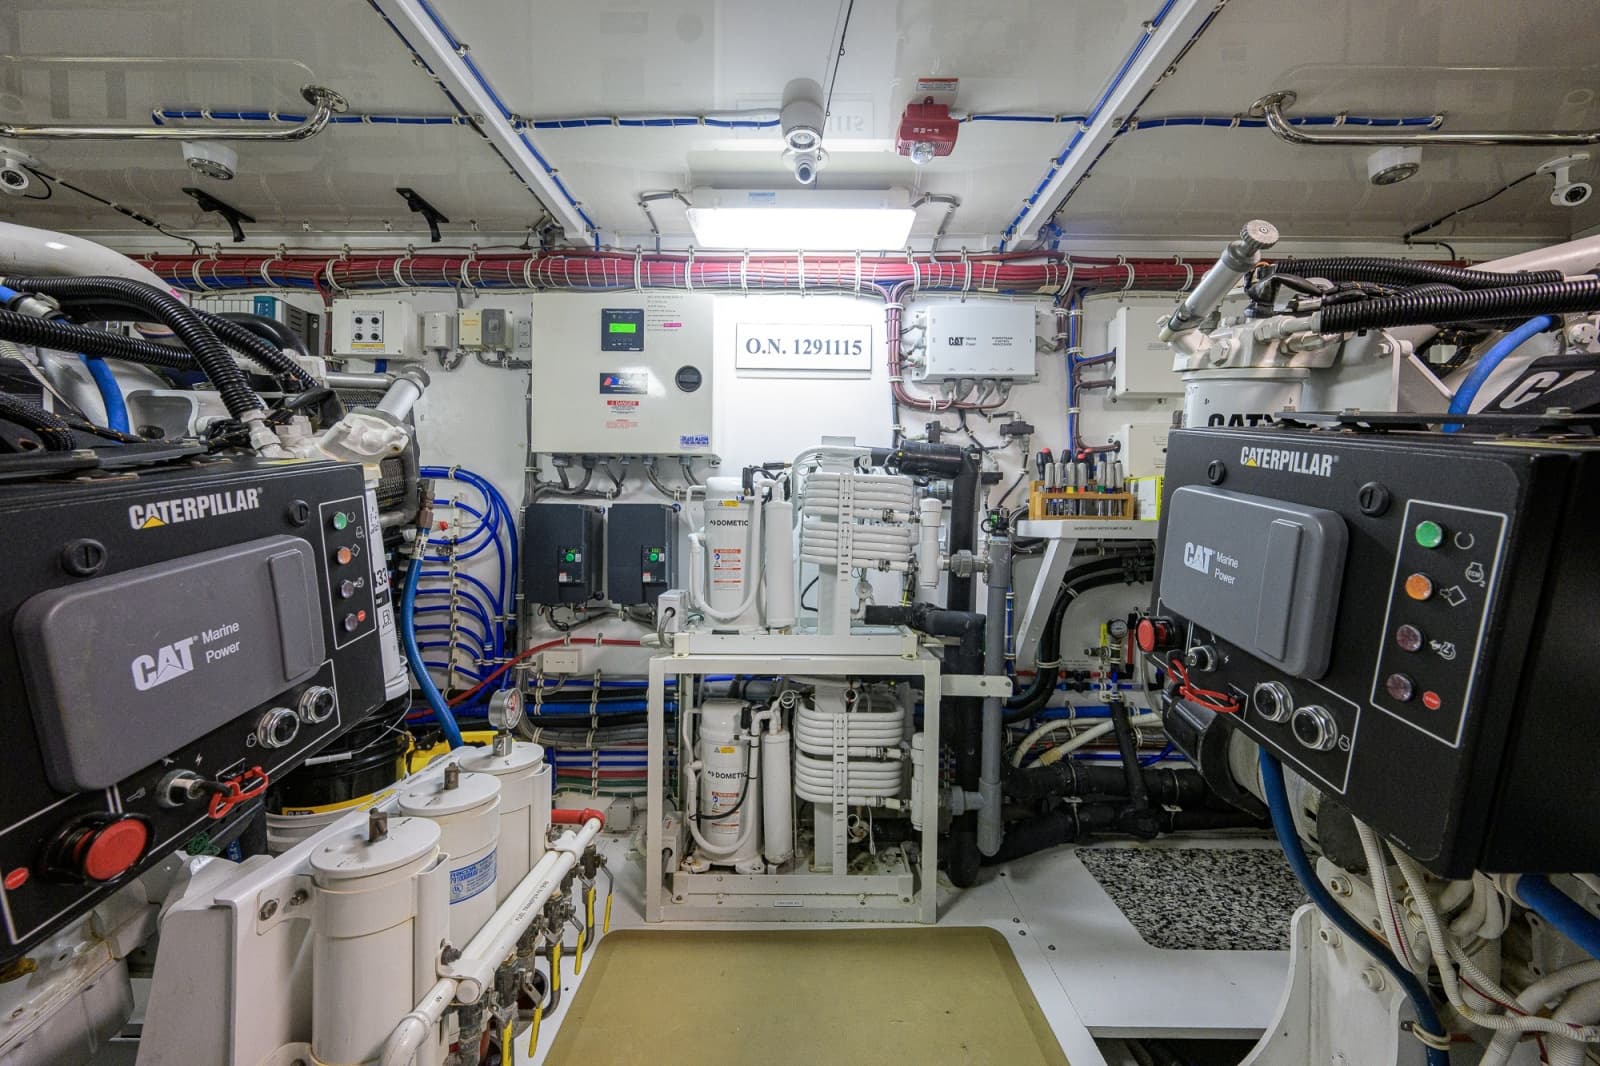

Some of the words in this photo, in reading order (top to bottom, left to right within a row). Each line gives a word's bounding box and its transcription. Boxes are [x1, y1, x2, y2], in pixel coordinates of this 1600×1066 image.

[745, 337, 787, 355] O.N.
[794, 338, 863, 356] 1291115
[948, 336, 965, 346] CAT
[1240, 446, 1333, 478] CATERPILLAR
[129, 487, 260, 530] CATERPILLAR
[716, 519, 749, 527] DOMETIC
[1184, 542, 1215, 575] CAT
[1216, 551, 1239, 569] Marine
[1214, 568, 1236, 585] Power
[202, 621, 240, 645] Marine
[131, 636, 195, 691] CAT
[205, 640, 241, 664] Power
